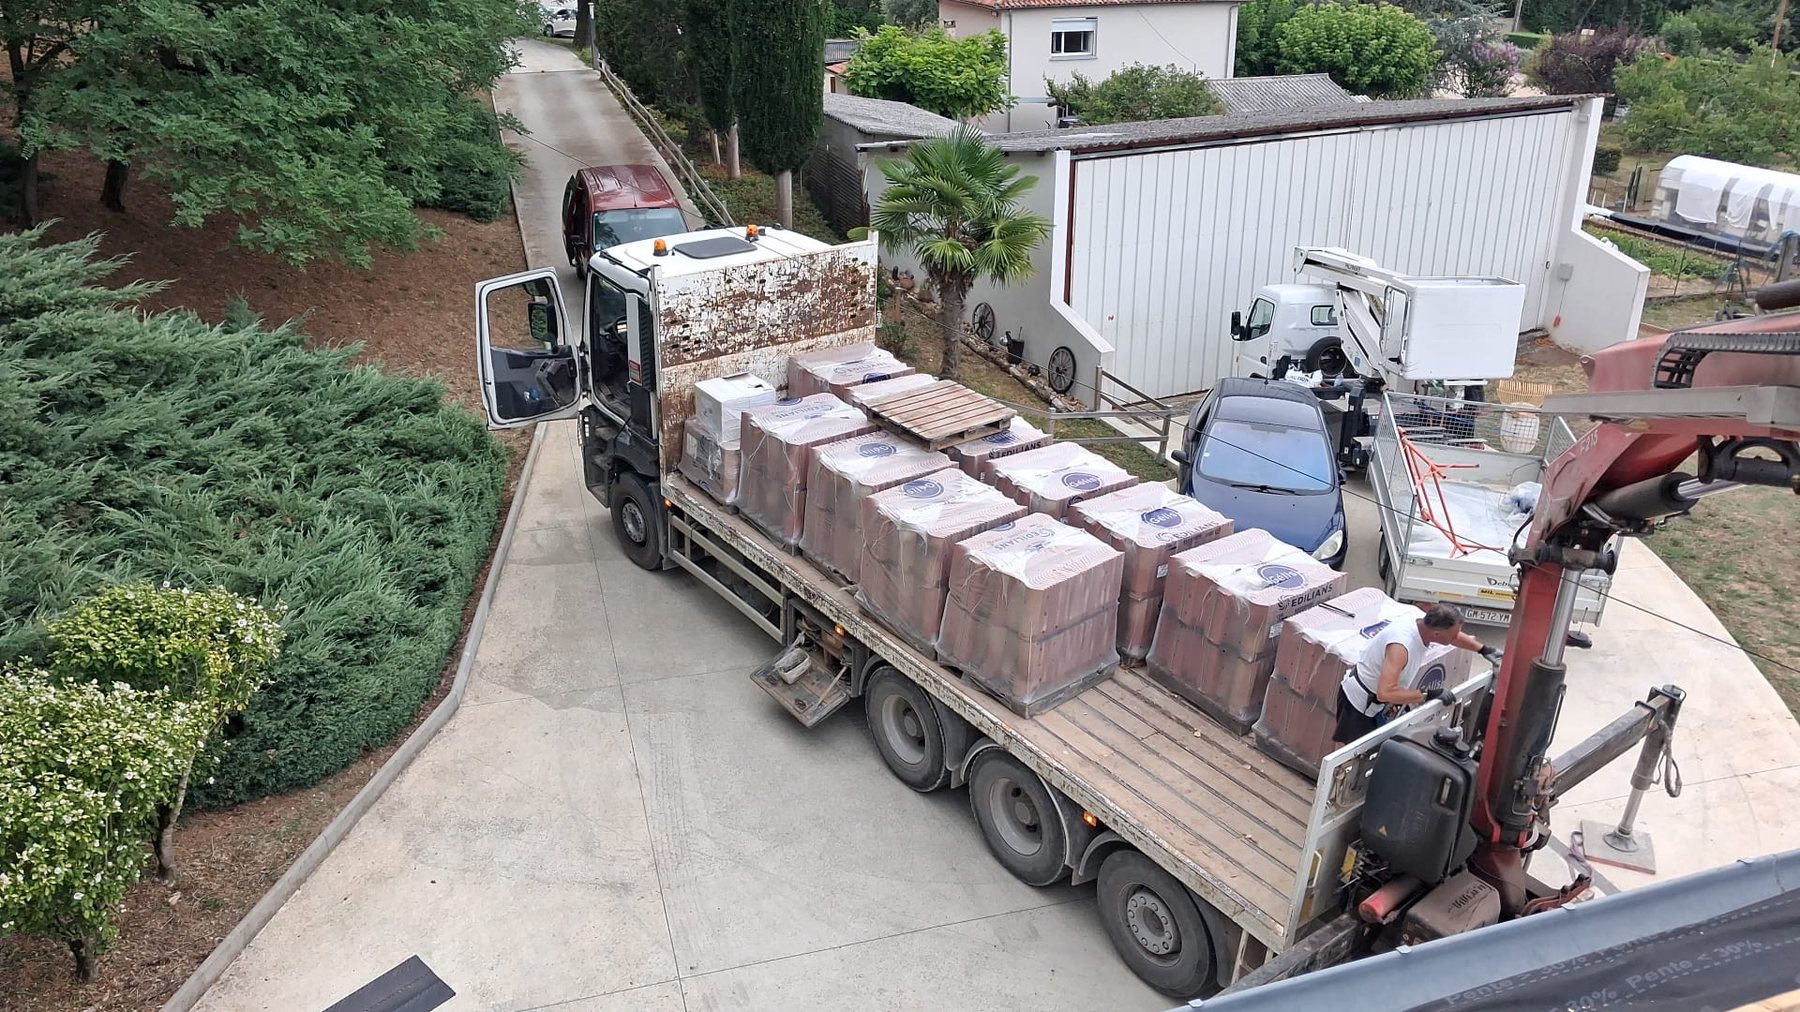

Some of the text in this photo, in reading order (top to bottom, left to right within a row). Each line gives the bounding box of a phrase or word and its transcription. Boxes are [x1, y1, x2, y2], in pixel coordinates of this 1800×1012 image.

[995, 531, 1040, 550] EDILIANS
[1291, 584, 1334, 607] EDILIANS
[1625, 960, 1693, 989] Pente
[1713, 940, 1762, 957] 30%
